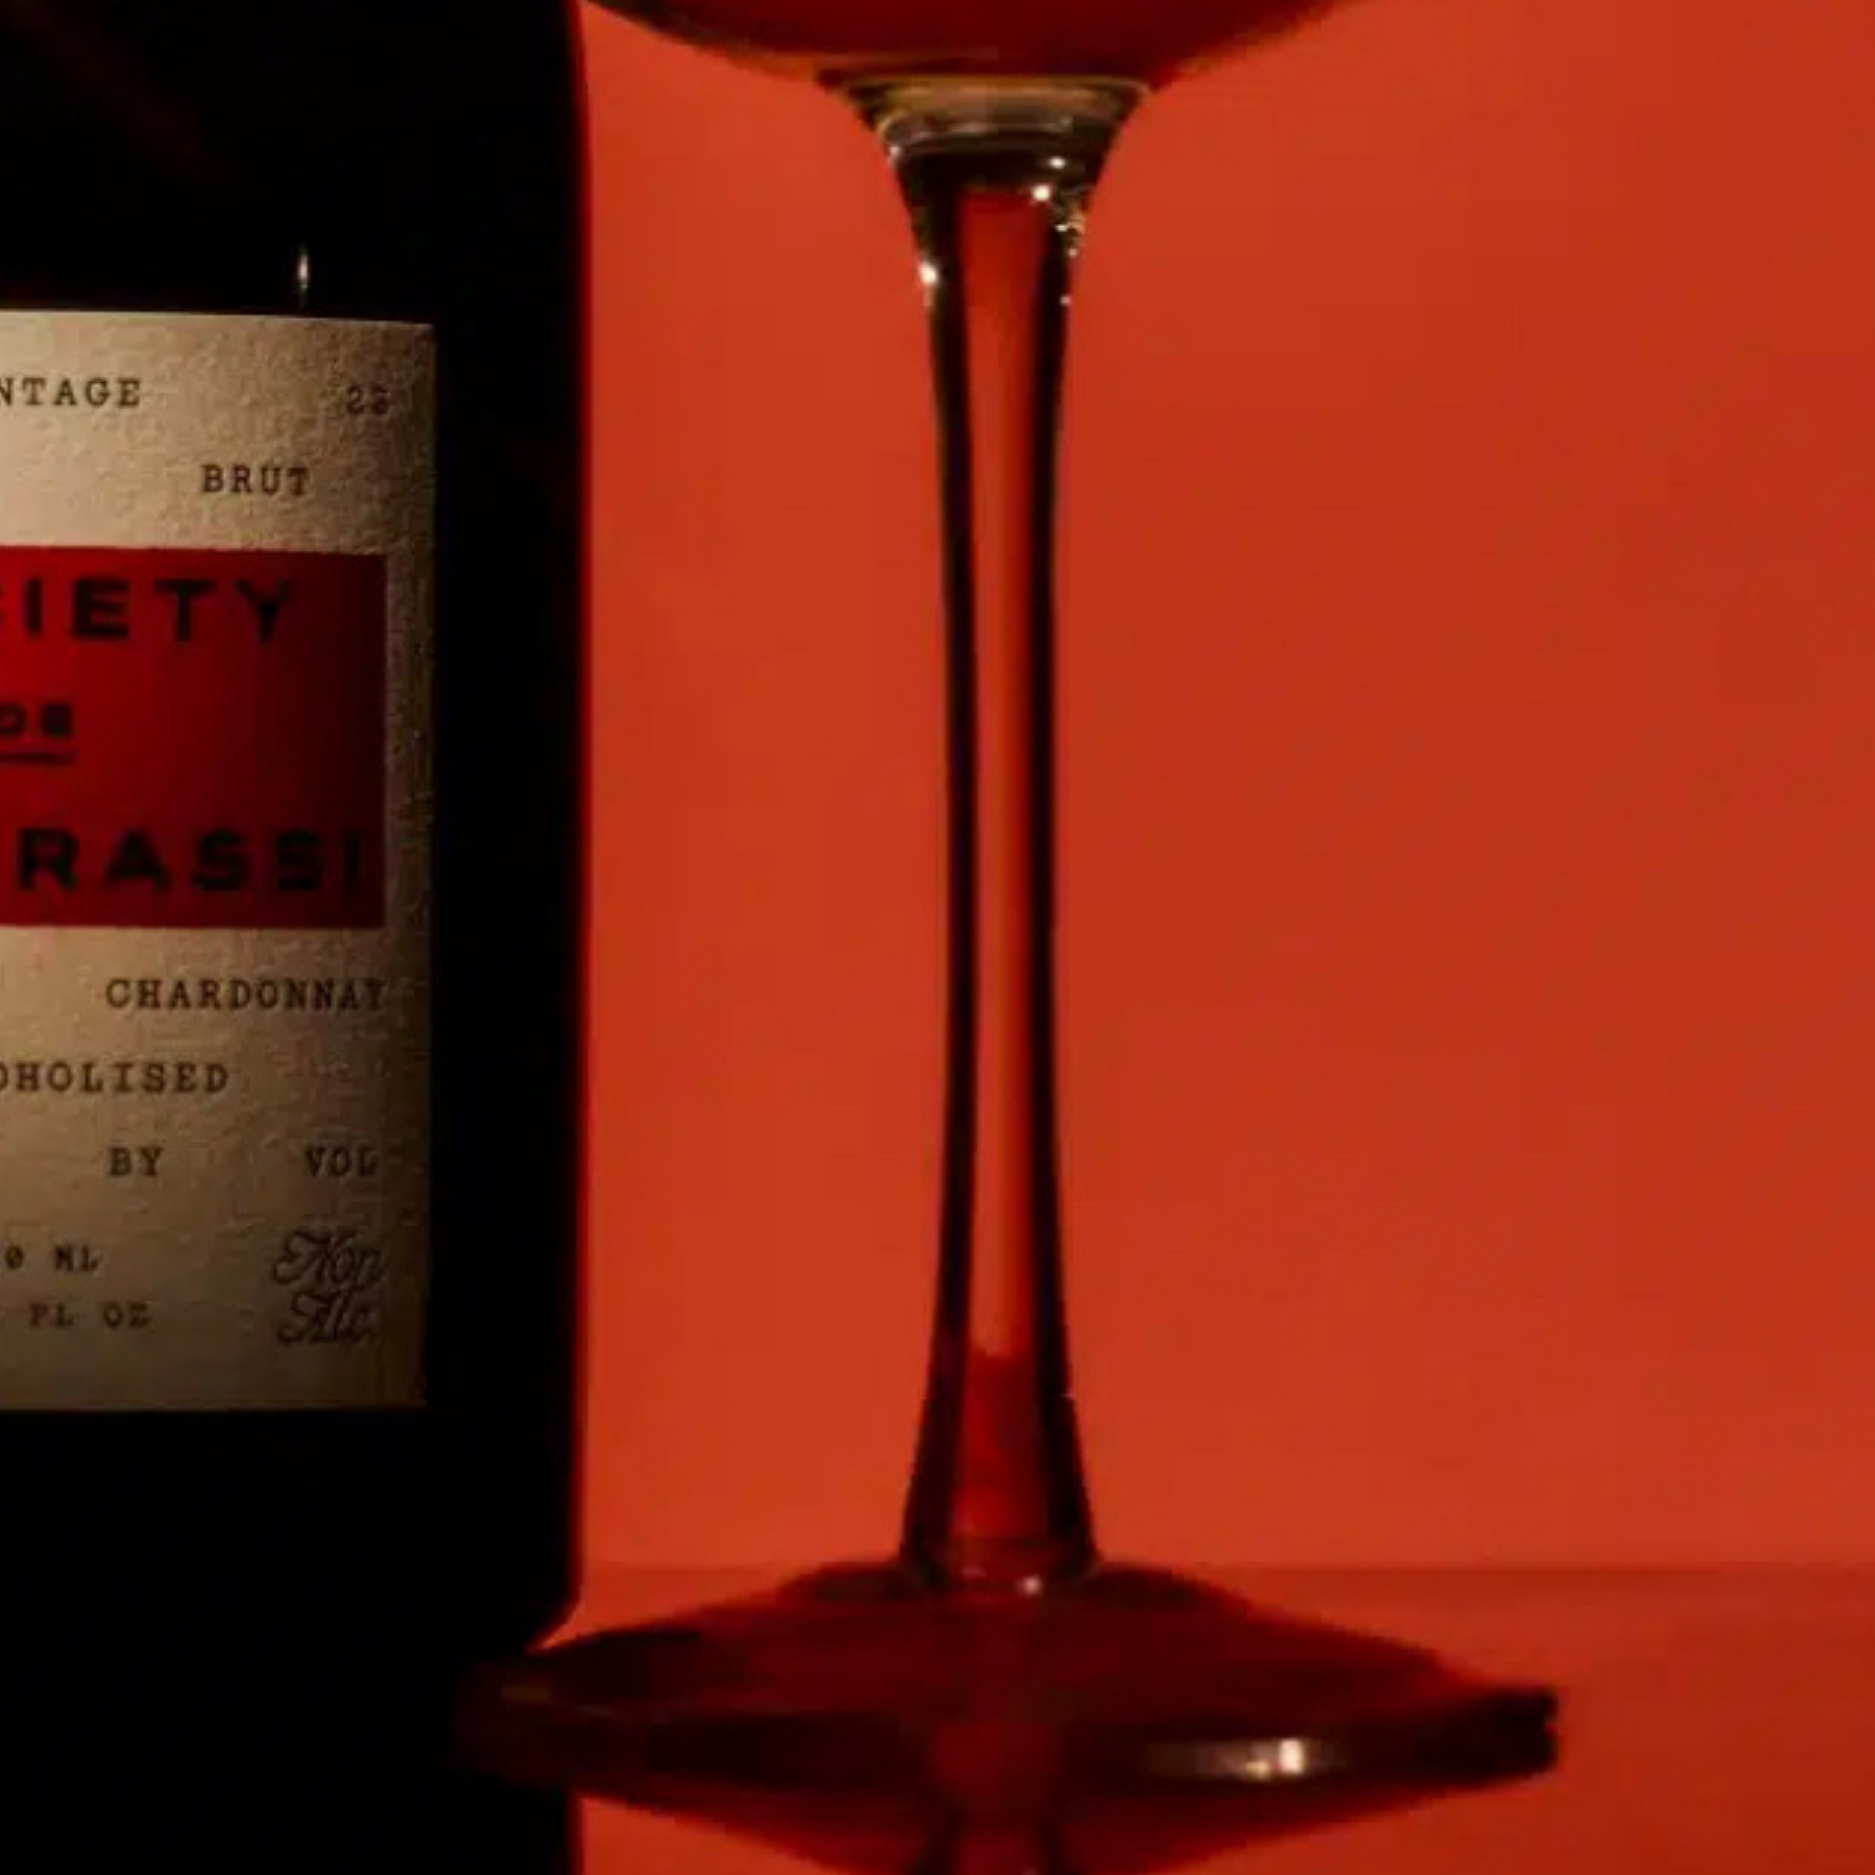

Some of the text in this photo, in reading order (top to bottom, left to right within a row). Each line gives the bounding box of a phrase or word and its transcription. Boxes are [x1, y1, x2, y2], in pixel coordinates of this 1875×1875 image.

[200, 464, 311, 497] BRUT
[18, 827, 368, 893] RASSI
[105, 978, 386, 1011] CHARDONNAY
[109, 1147, 164, 1178] BY
[304, 1147, 379, 1177] VOL
[54, 1245, 103, 1273] ML
[29, 1302, 76, 1328] FL
[101, 1302, 152, 1329] OZ
